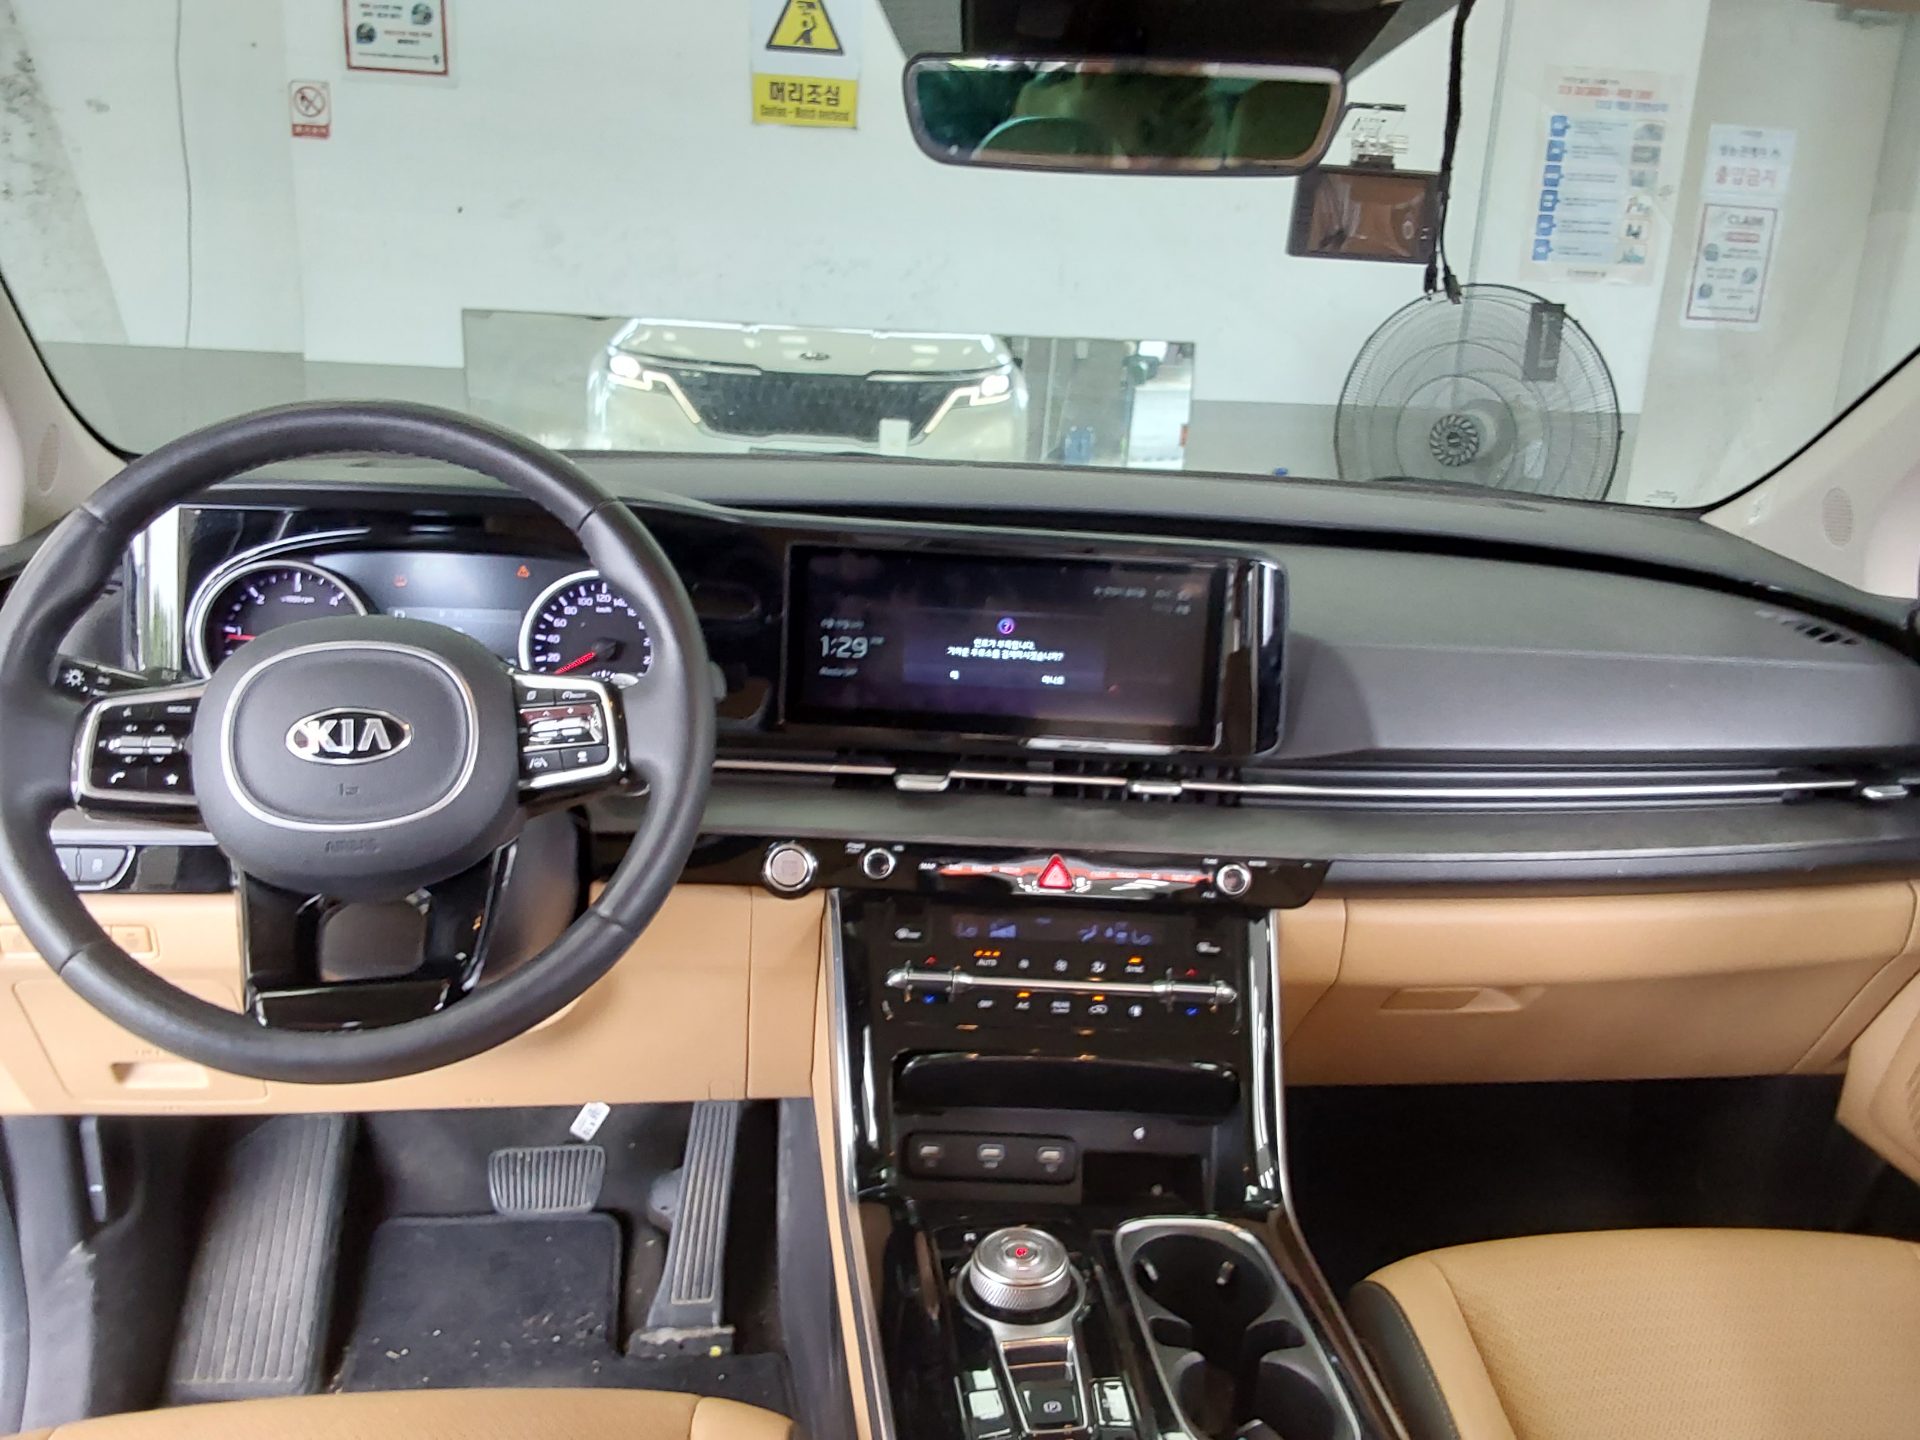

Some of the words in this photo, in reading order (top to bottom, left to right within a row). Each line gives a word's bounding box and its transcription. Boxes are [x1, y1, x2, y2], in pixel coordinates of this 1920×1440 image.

[768, 81, 840, 107] 머리조심
[577, 597, 593, 607] 100
[596, 593, 612, 603] 120
[563, 606, 578, 616] 80
[553, 618, 567, 628] 60
[547, 634, 561, 644] 40
[820, 635, 868, 659] 1:29
[547, 652, 561, 663] 20
[304, 717, 392, 755] KIA
[976, 958, 998, 967] AUTO
